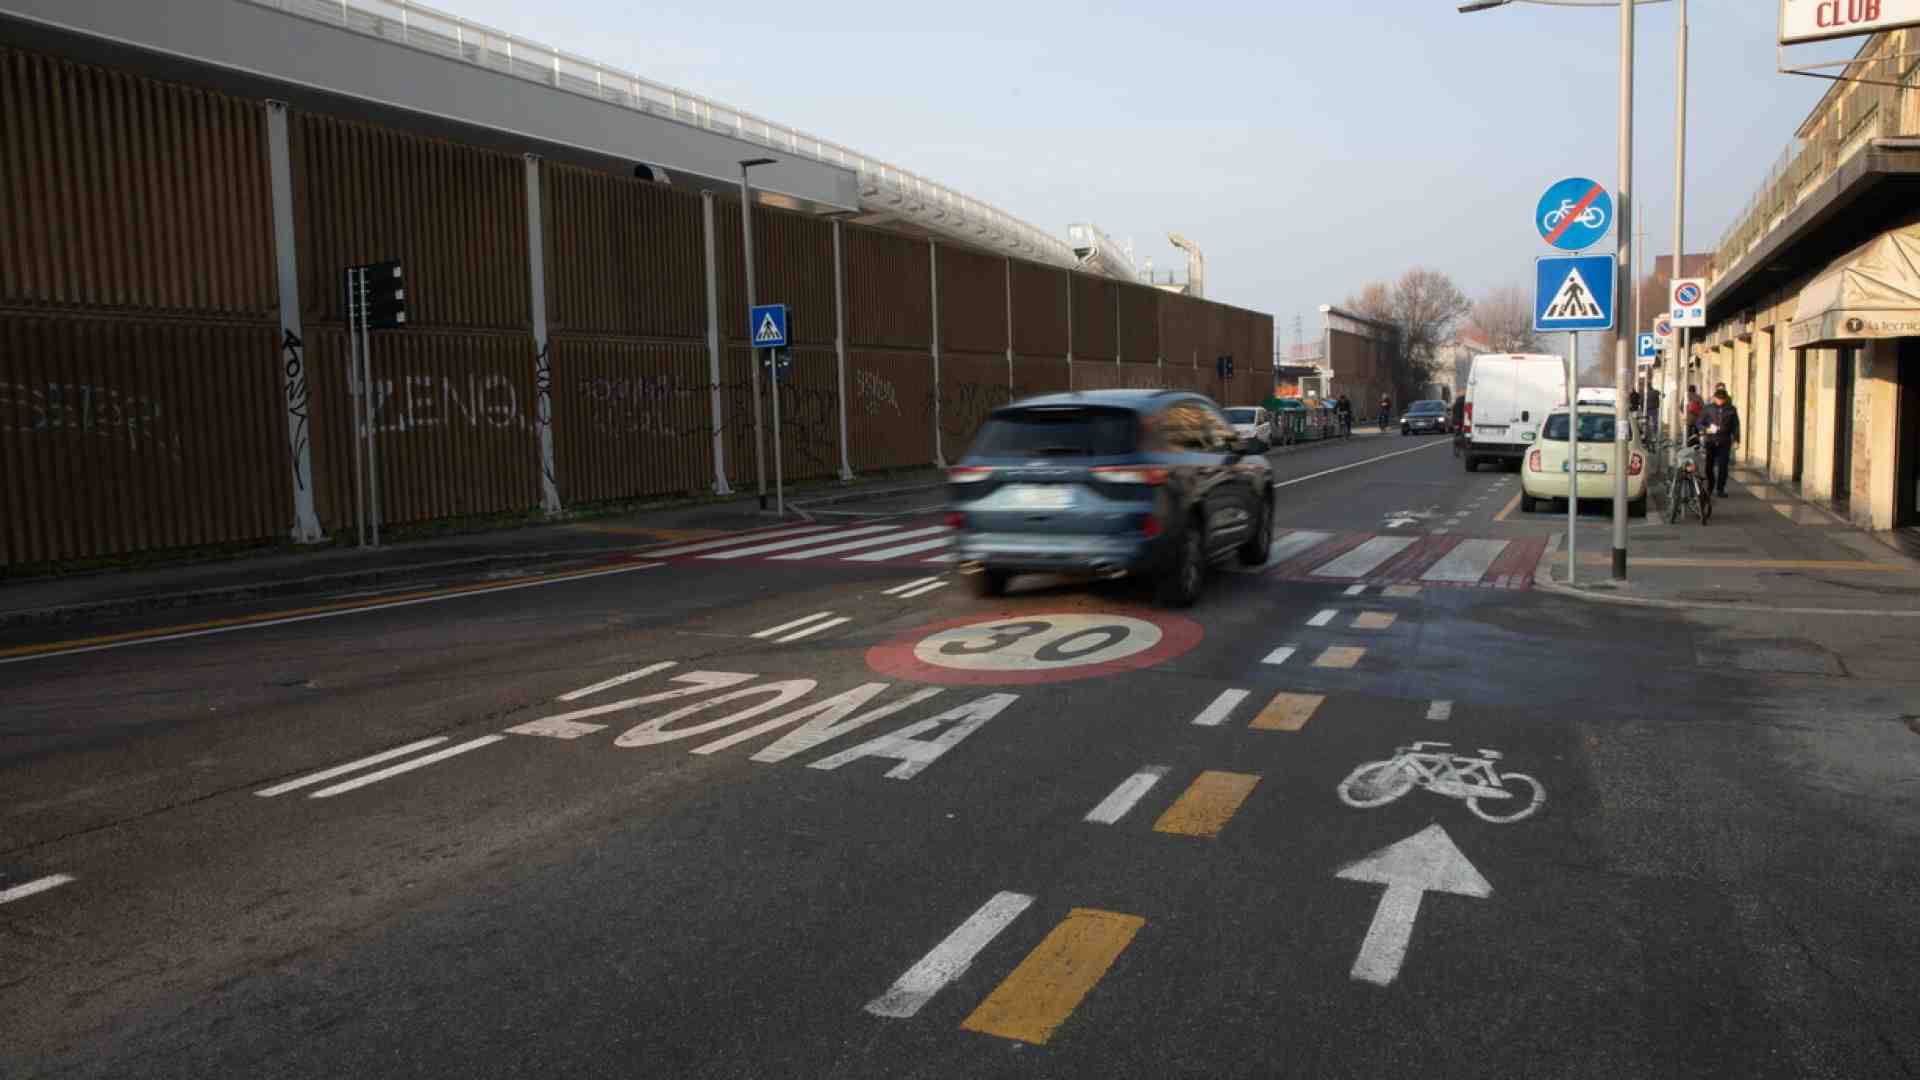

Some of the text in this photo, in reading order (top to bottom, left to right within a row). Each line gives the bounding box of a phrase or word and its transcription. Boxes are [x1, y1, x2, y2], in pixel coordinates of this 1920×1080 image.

[1816, 0, 1881, 27] CLUB
[1640, 335, 1653, 355] P
[939, 621, 1131, 662] 30
[503, 670, 1021, 780] ZONA
